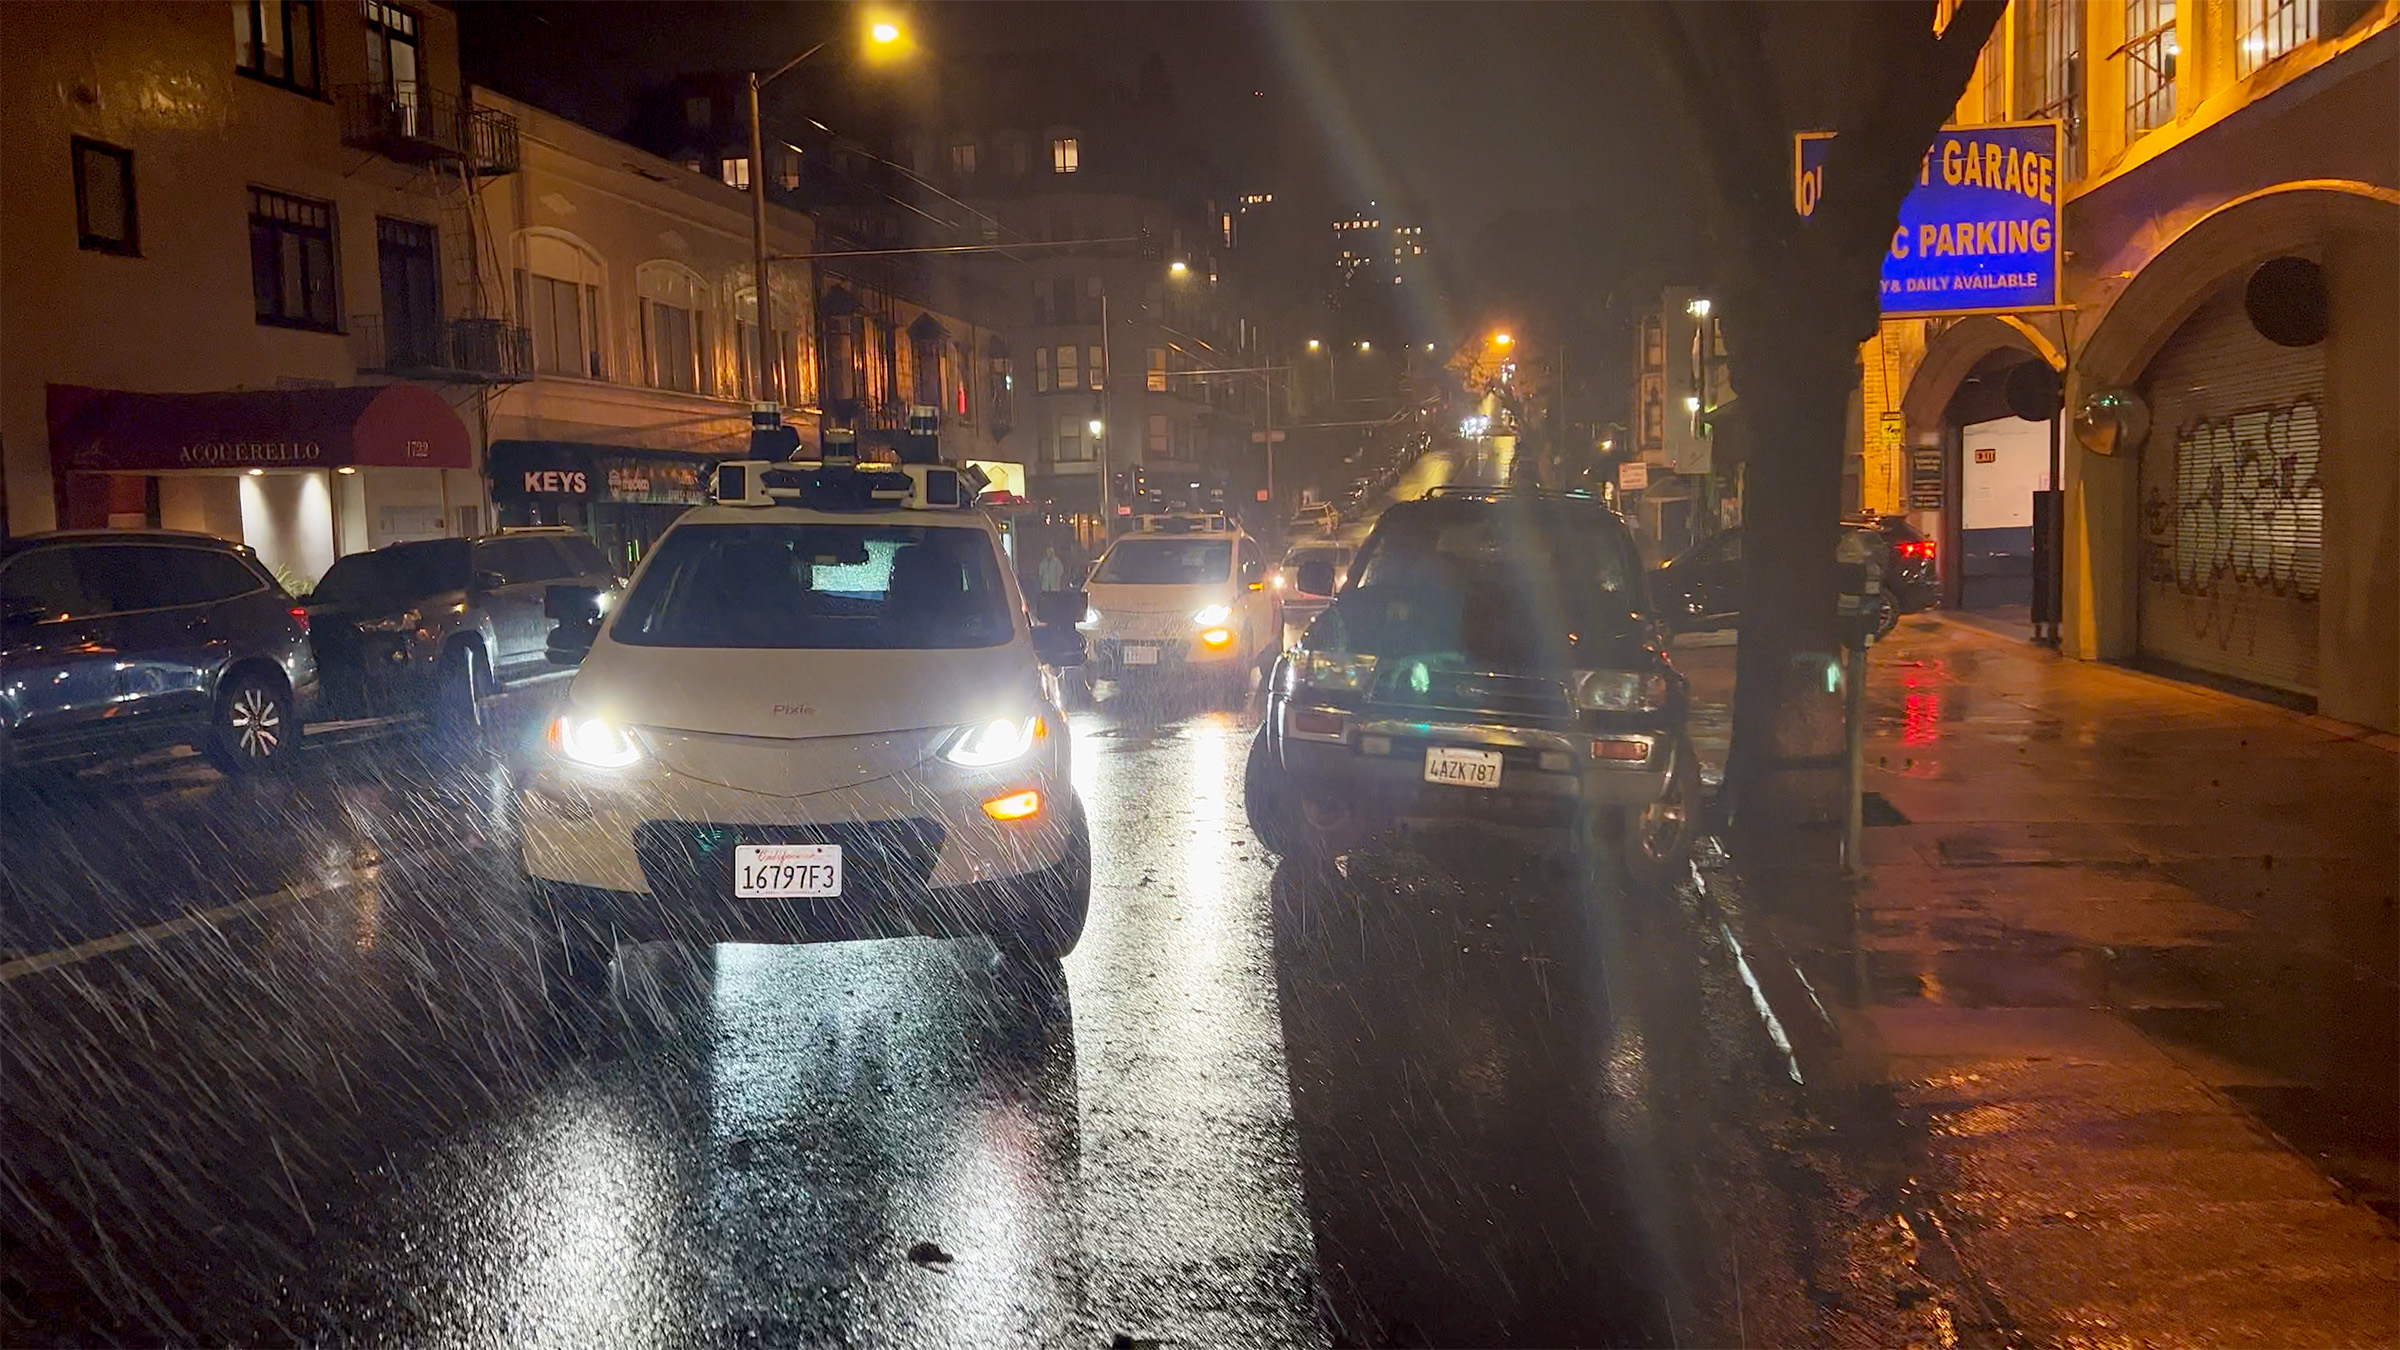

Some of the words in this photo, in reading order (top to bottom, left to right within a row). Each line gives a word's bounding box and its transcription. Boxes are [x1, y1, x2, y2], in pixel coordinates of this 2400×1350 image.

[1943, 139, 2053, 206] GARAGE
[1919, 217, 2051, 258] PARKING
[1906, 275, 1949, 292] DAILY
[1953, 271, 2038, 290] AVAILABLE
[180, 442, 320, 463] ACQUERELLO
[1976, 450, 1996, 462] EXIT
[524, 470, 587, 494] KEYS
[773, 704, 815, 716] Pixie
[1430, 760, 1496, 782] 4AZK787
[743, 865, 834, 890] 16797F3
